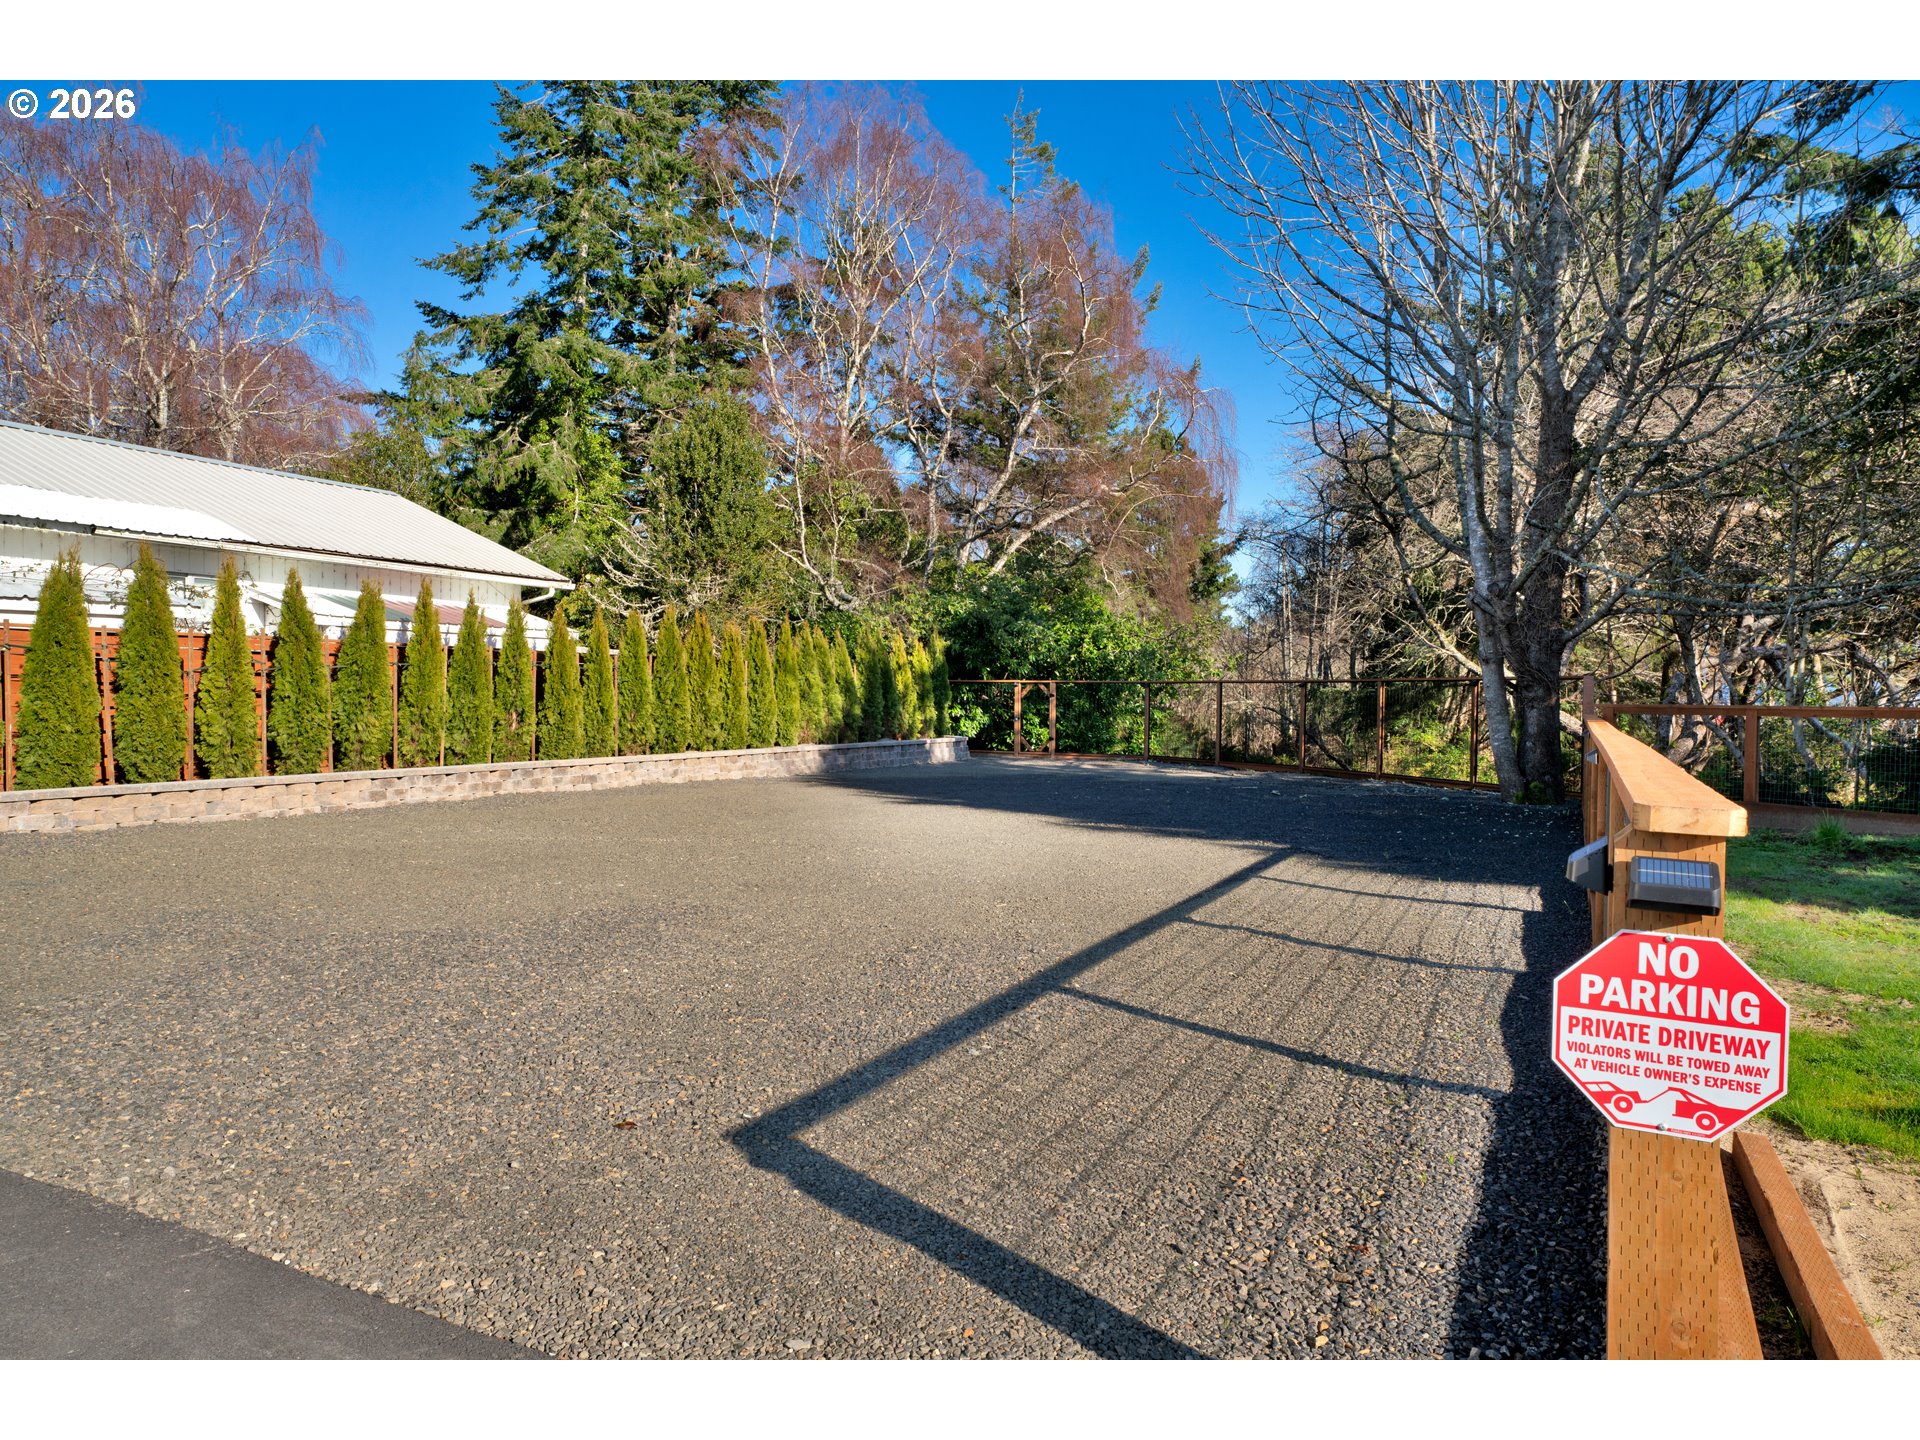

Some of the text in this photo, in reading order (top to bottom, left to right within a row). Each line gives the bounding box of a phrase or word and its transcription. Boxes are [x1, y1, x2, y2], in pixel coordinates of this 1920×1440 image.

[1638, 942, 1700, 980] NO
[1579, 973, 1761, 1026] PARKING
[1568, 1015, 1771, 1060] PRIVATE DRIVEWAY
[1567, 1040, 1771, 1079] VIOLATORS WILL BE TOWED AWAY
[1574, 1057, 1762, 1095] AT VEHICLE OWNER'S EXPENSE
